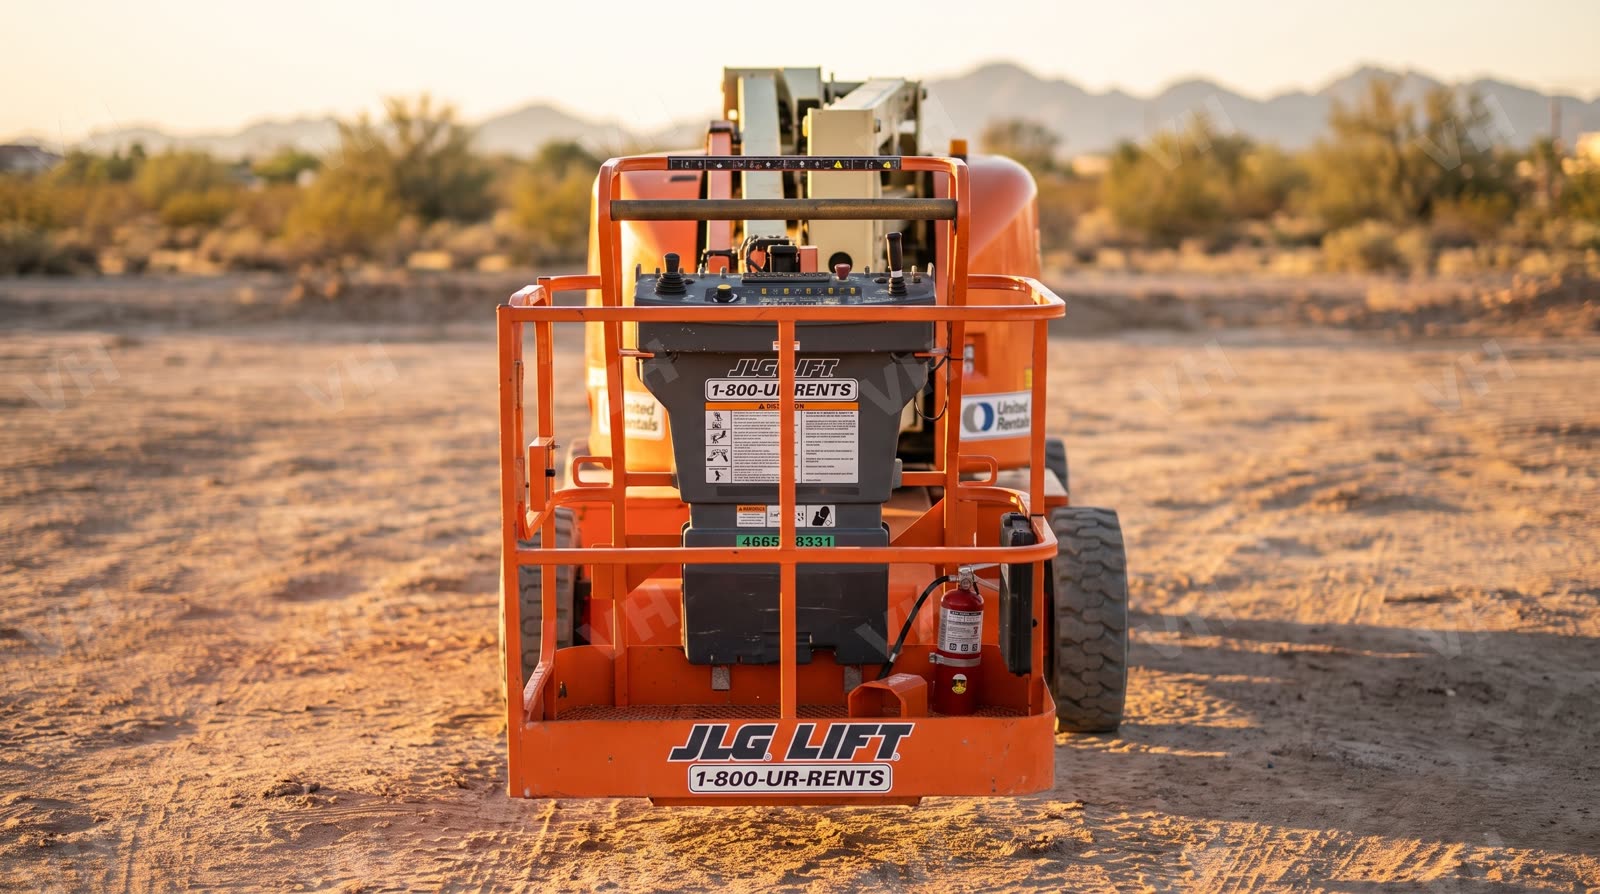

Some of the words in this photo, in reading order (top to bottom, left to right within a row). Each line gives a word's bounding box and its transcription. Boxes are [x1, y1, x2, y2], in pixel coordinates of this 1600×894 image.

[794, 359, 840, 377] IFT
[997, 400, 1028, 415] United
[667, 723, 778, 762] JLG
[784, 723, 915, 762] LIFT
[696, 770, 884, 786] 1-800-UR-RENTS
